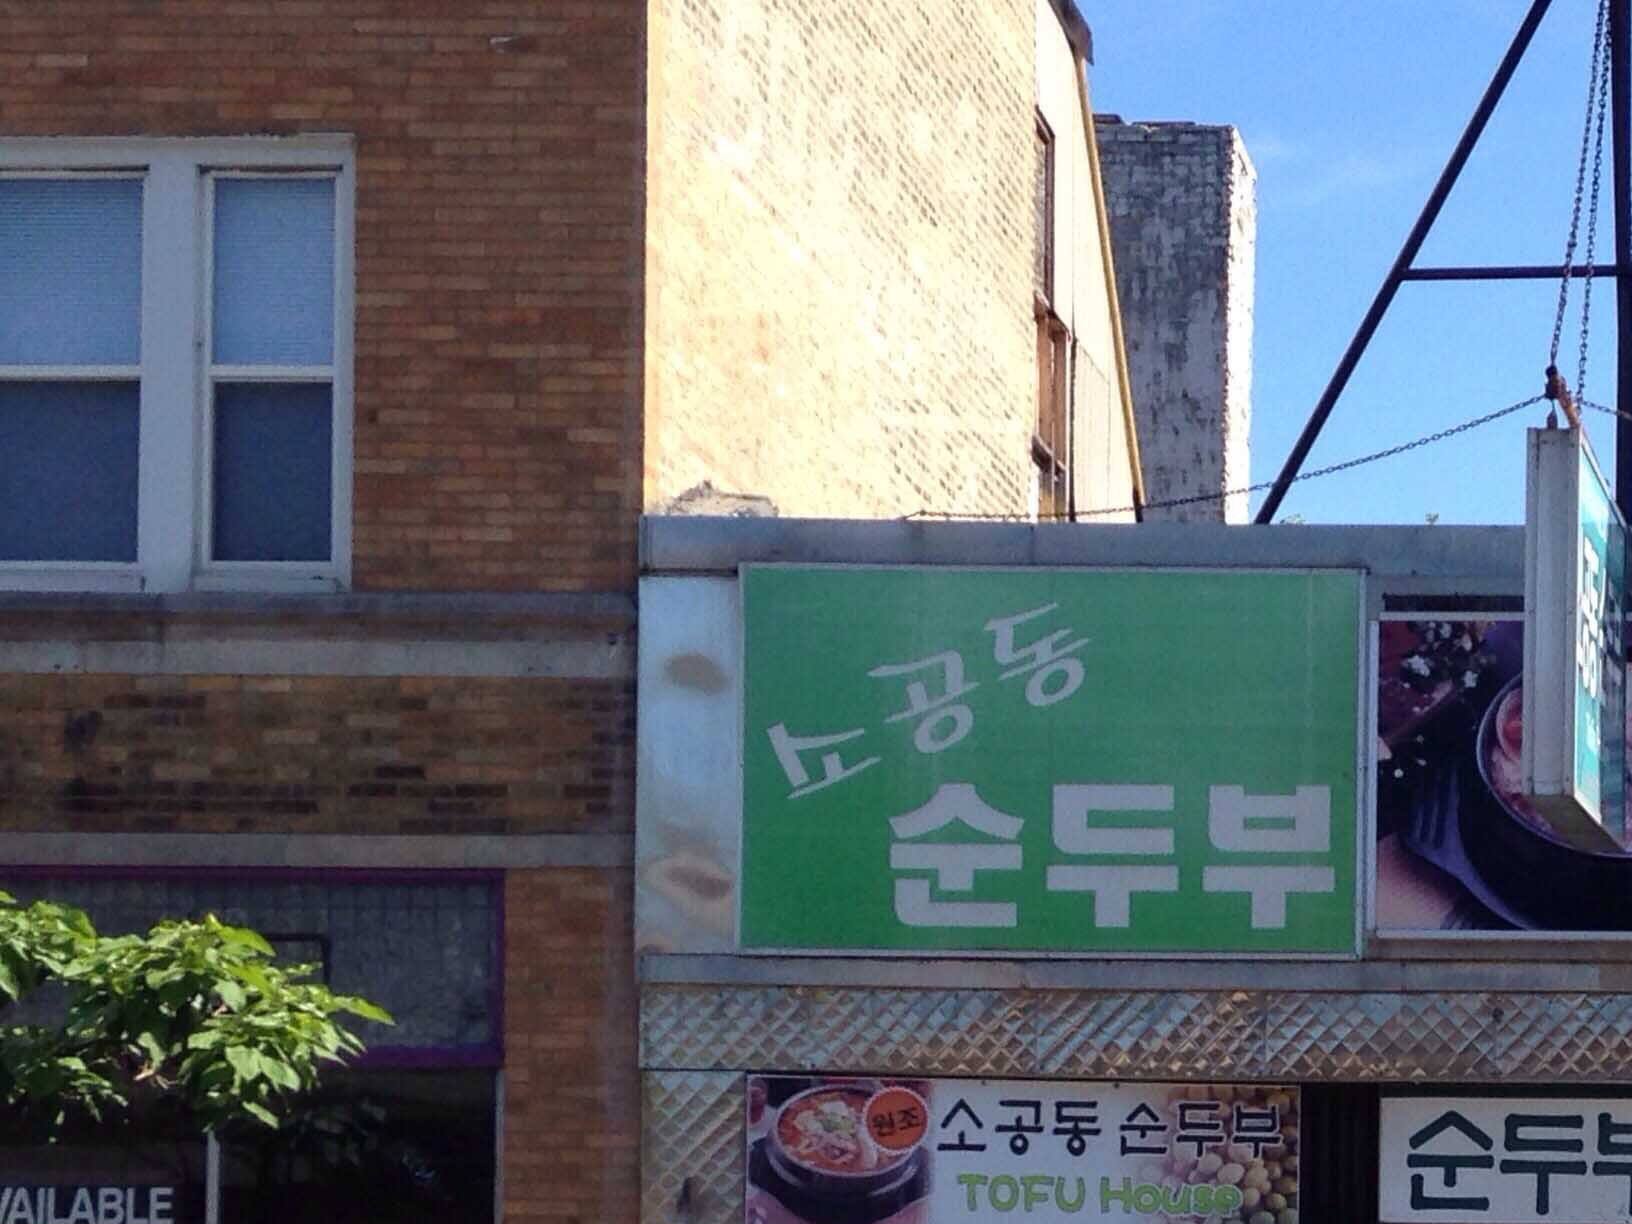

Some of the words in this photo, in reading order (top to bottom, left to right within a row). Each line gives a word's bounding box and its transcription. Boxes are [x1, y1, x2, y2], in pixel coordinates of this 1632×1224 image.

[766, 601, 1091, 800] 소공동
[889, 783, 1335, 930] 순두부
[936, 1098, 1101, 1156] 소공동
[1119, 1101, 1284, 1158] 순두부
[958, 1172, 1086, 1214] TOFU
[1100, 1177, 1243, 1216] House
